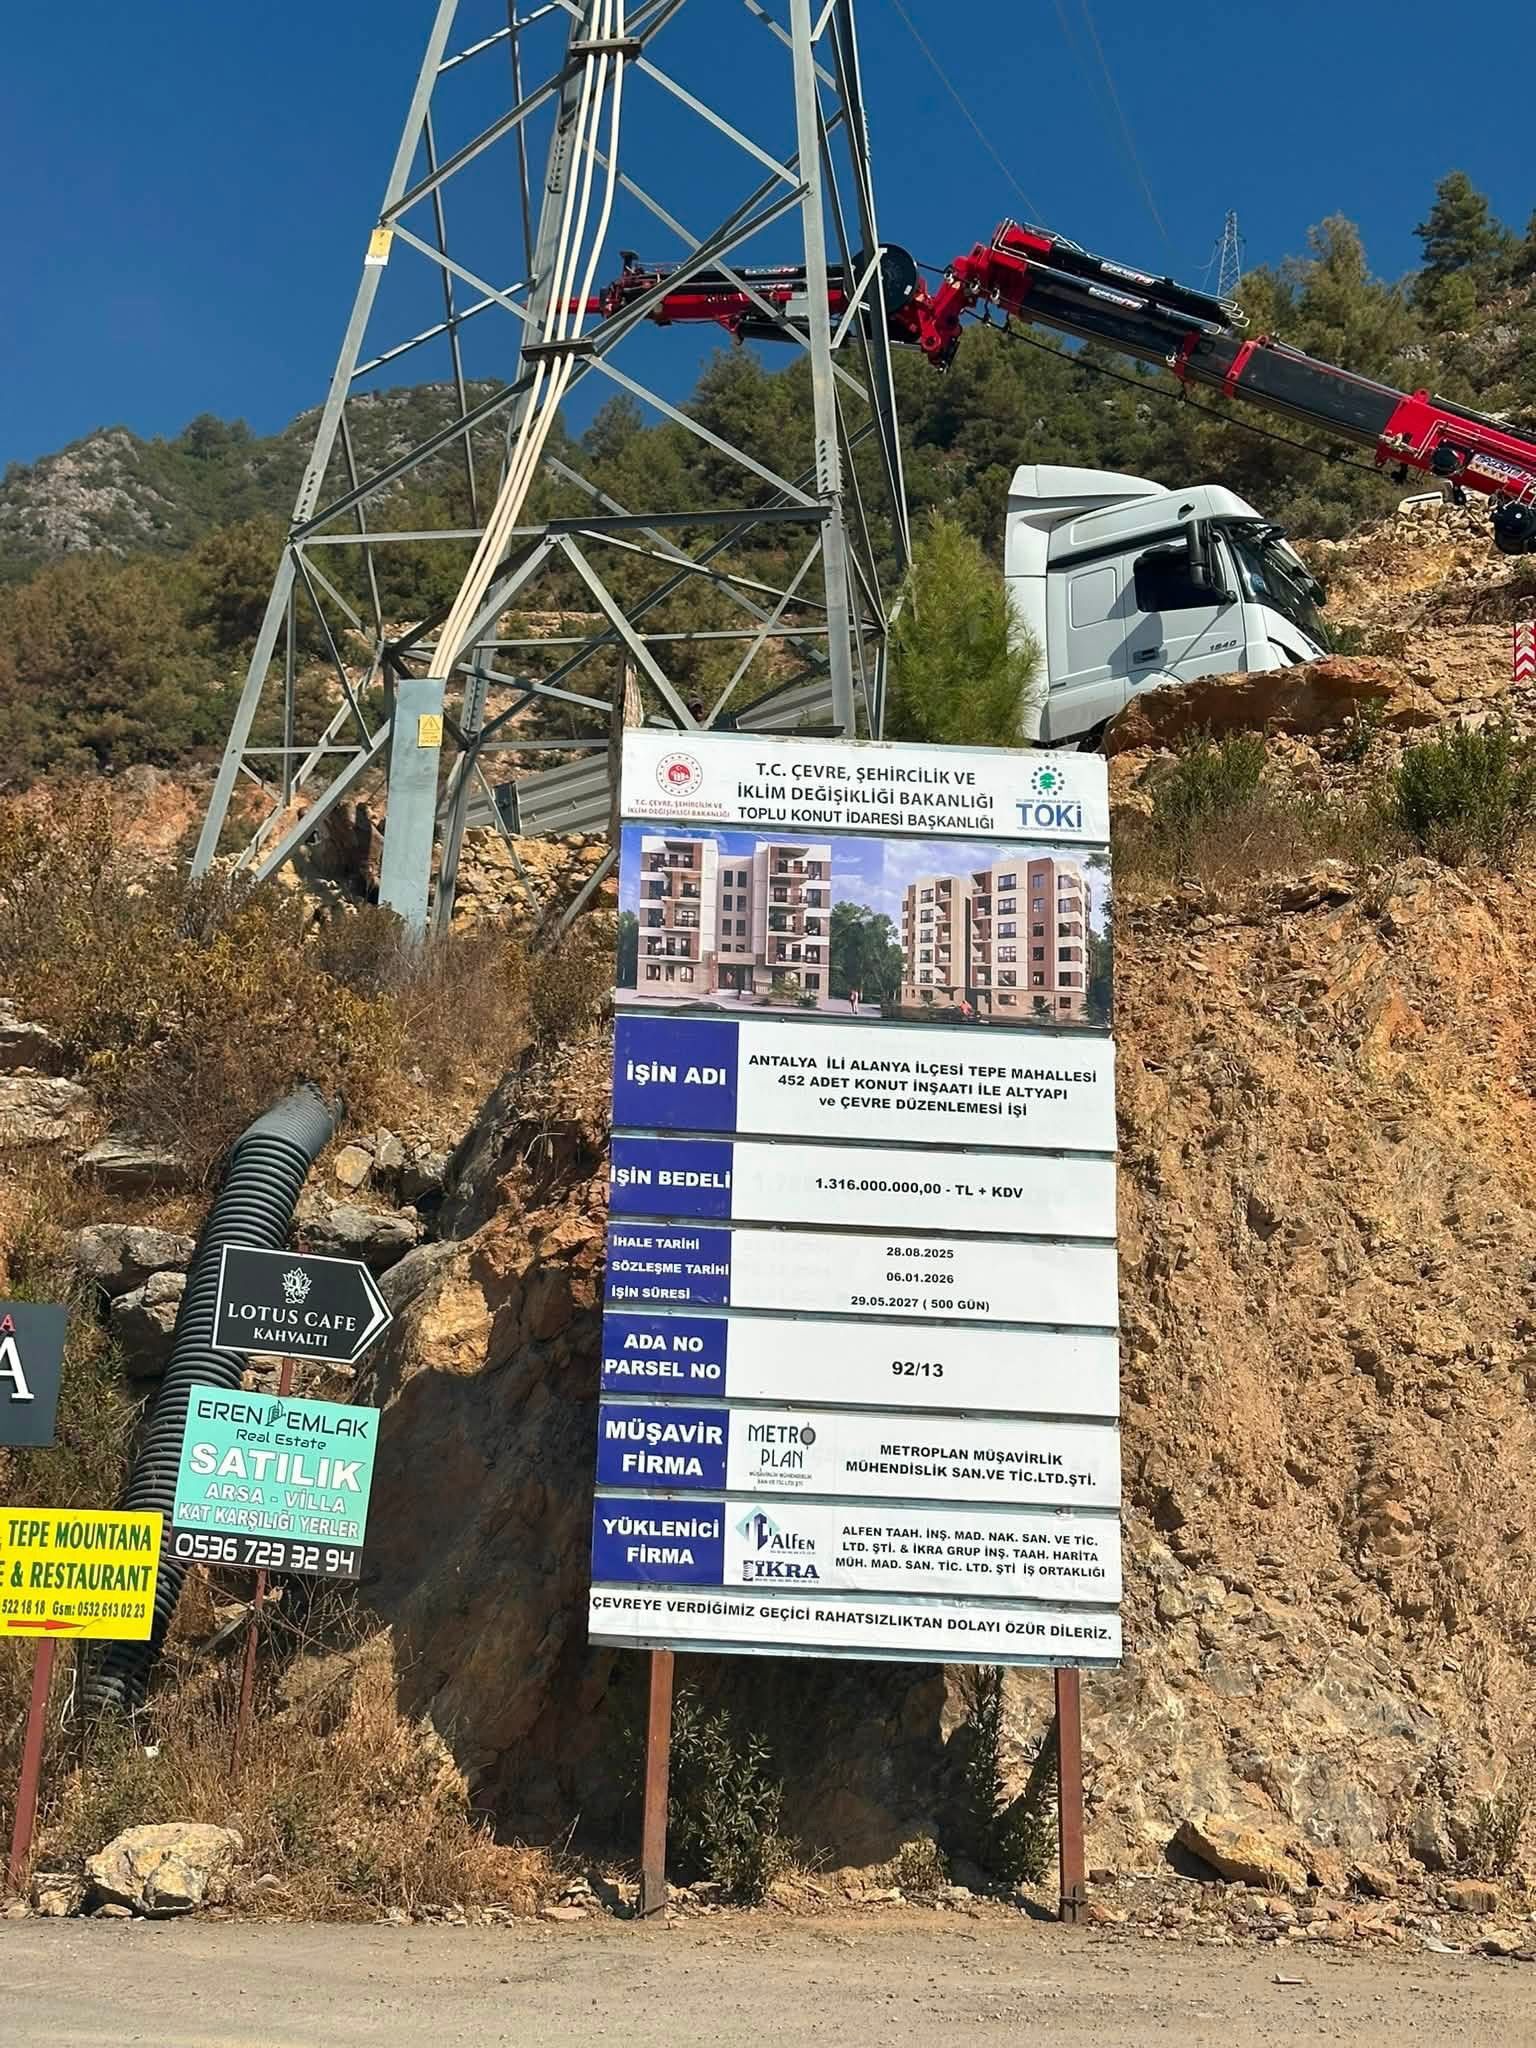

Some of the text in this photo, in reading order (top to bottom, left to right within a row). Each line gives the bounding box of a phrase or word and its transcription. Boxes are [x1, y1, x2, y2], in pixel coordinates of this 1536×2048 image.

[755, 762, 976, 785] T.C. ÇEVRE, ŞEHİRCİLİK VE
[737, 782, 994, 809] İKLİM DEĞİŞİKLİĞİ BAKANLIĞI
[738, 806, 994, 830] TOPLU KONUT İDARESİ BAŞKANLIĞI
[626, 1060, 726, 1086] İŞİN ADI
[749, 1054, 1097, 1083] ANTALYA İLİ ALANYA İLÇESİ TEPE MAHALLESİ
[778, 1075, 1067, 1100] 452 ADET KONUT İNŞAATI İLE ALTYAPI
[819, 1096, 1027, 1118] ve ÇEVRE DÜZENLEMESİ İŞİ
[610, 1165, 731, 1189] İŞİN BEDELİ
[815, 1178, 941, 1195] 1.316.000.000,00
[955, 1185, 973, 1196] TL
[978, 1187, 987, 1195] +
[992, 1186, 1023, 1198] KDV
[613, 1234, 700, 1250] İHALE TARİHİ
[886, 1247, 954, 1259] 28.08.2025
[612, 1261, 729, 1276] SÖZLEŞME TARİHİ
[886, 1272, 954, 1284] 06.01.2026
[611, 1285, 691, 1299] İŞİN SÜRESİ
[851, 1296, 918, 1308] 29.05.2027
[931, 1300, 954, 1309] 500
[957, 1299, 990, 1312] GÜN)
[228, 1303, 357, 1332] LOTUS CAFE
[253, 1328, 328, 1347] KAHVALTI
[624, 1334, 704, 1353] ADA NO
[605, 1359, 721, 1379] PARSEL NO
[891, 1361, 944, 1378] 92/13
[197, 1400, 369, 1439] EREN EMLAK
[236, 1428, 327, 1450] Real Estate
[605, 1418, 723, 1445] MÜŞAVİR
[748, 1424, 816, 1446] METRO
[622, 1451, 703, 1476] FİRMA
[761, 1448, 803, 1469] PLAN
[880, 1444, 1063, 1466] METROPLAN MÜŞAVİRLİK
[189, 1442, 366, 1492] SATILIK
[846, 1460, 1096, 1486] MÜHENDİSLİK SAN.VE TİC.LTD.ŞTİ.
[205, 1482, 264, 1504] ARSA
[285, 1489, 346, 1513] VİLLA
[178, 1503, 359, 1539] KAT KARŞILIĞI YERLER
[602, 1516, 719, 1538] YÜKLENİCİ
[8, 1520, 152, 1551] TEPE MOUNTANA
[842, 1526, 1098, 1546] ALFEN TAAH. İNŞ. MAD. NAK. SAN. VE TİC.
[175, 1533, 354, 1573] 0536 723 32 94
[627, 1544, 694, 1565] FİRMA
[842, 1542, 1098, 1561] LTD. ŞTİ. & İKRA GRUP İNŞ. TAAH. HARİTA
[11, 1560, 23, 1588] &
[30, 1561, 152, 1592] RESTAURANT
[835, 1556, 1105, 1577] MÜH. MAD. SAN. TİC. LTD. ŞTİ İŞ ORTAKLIĞI
[2, 1599, 145, 1618] 522 18 18 Gsm: 0532 613 02 23
[592, 1596, 1112, 1640] ÇEVREYE VERDİĞİMİZ GEÇİCİ RAHATSIZLIKTAN DOLAYI ÖZÜR DİLERİZ.
